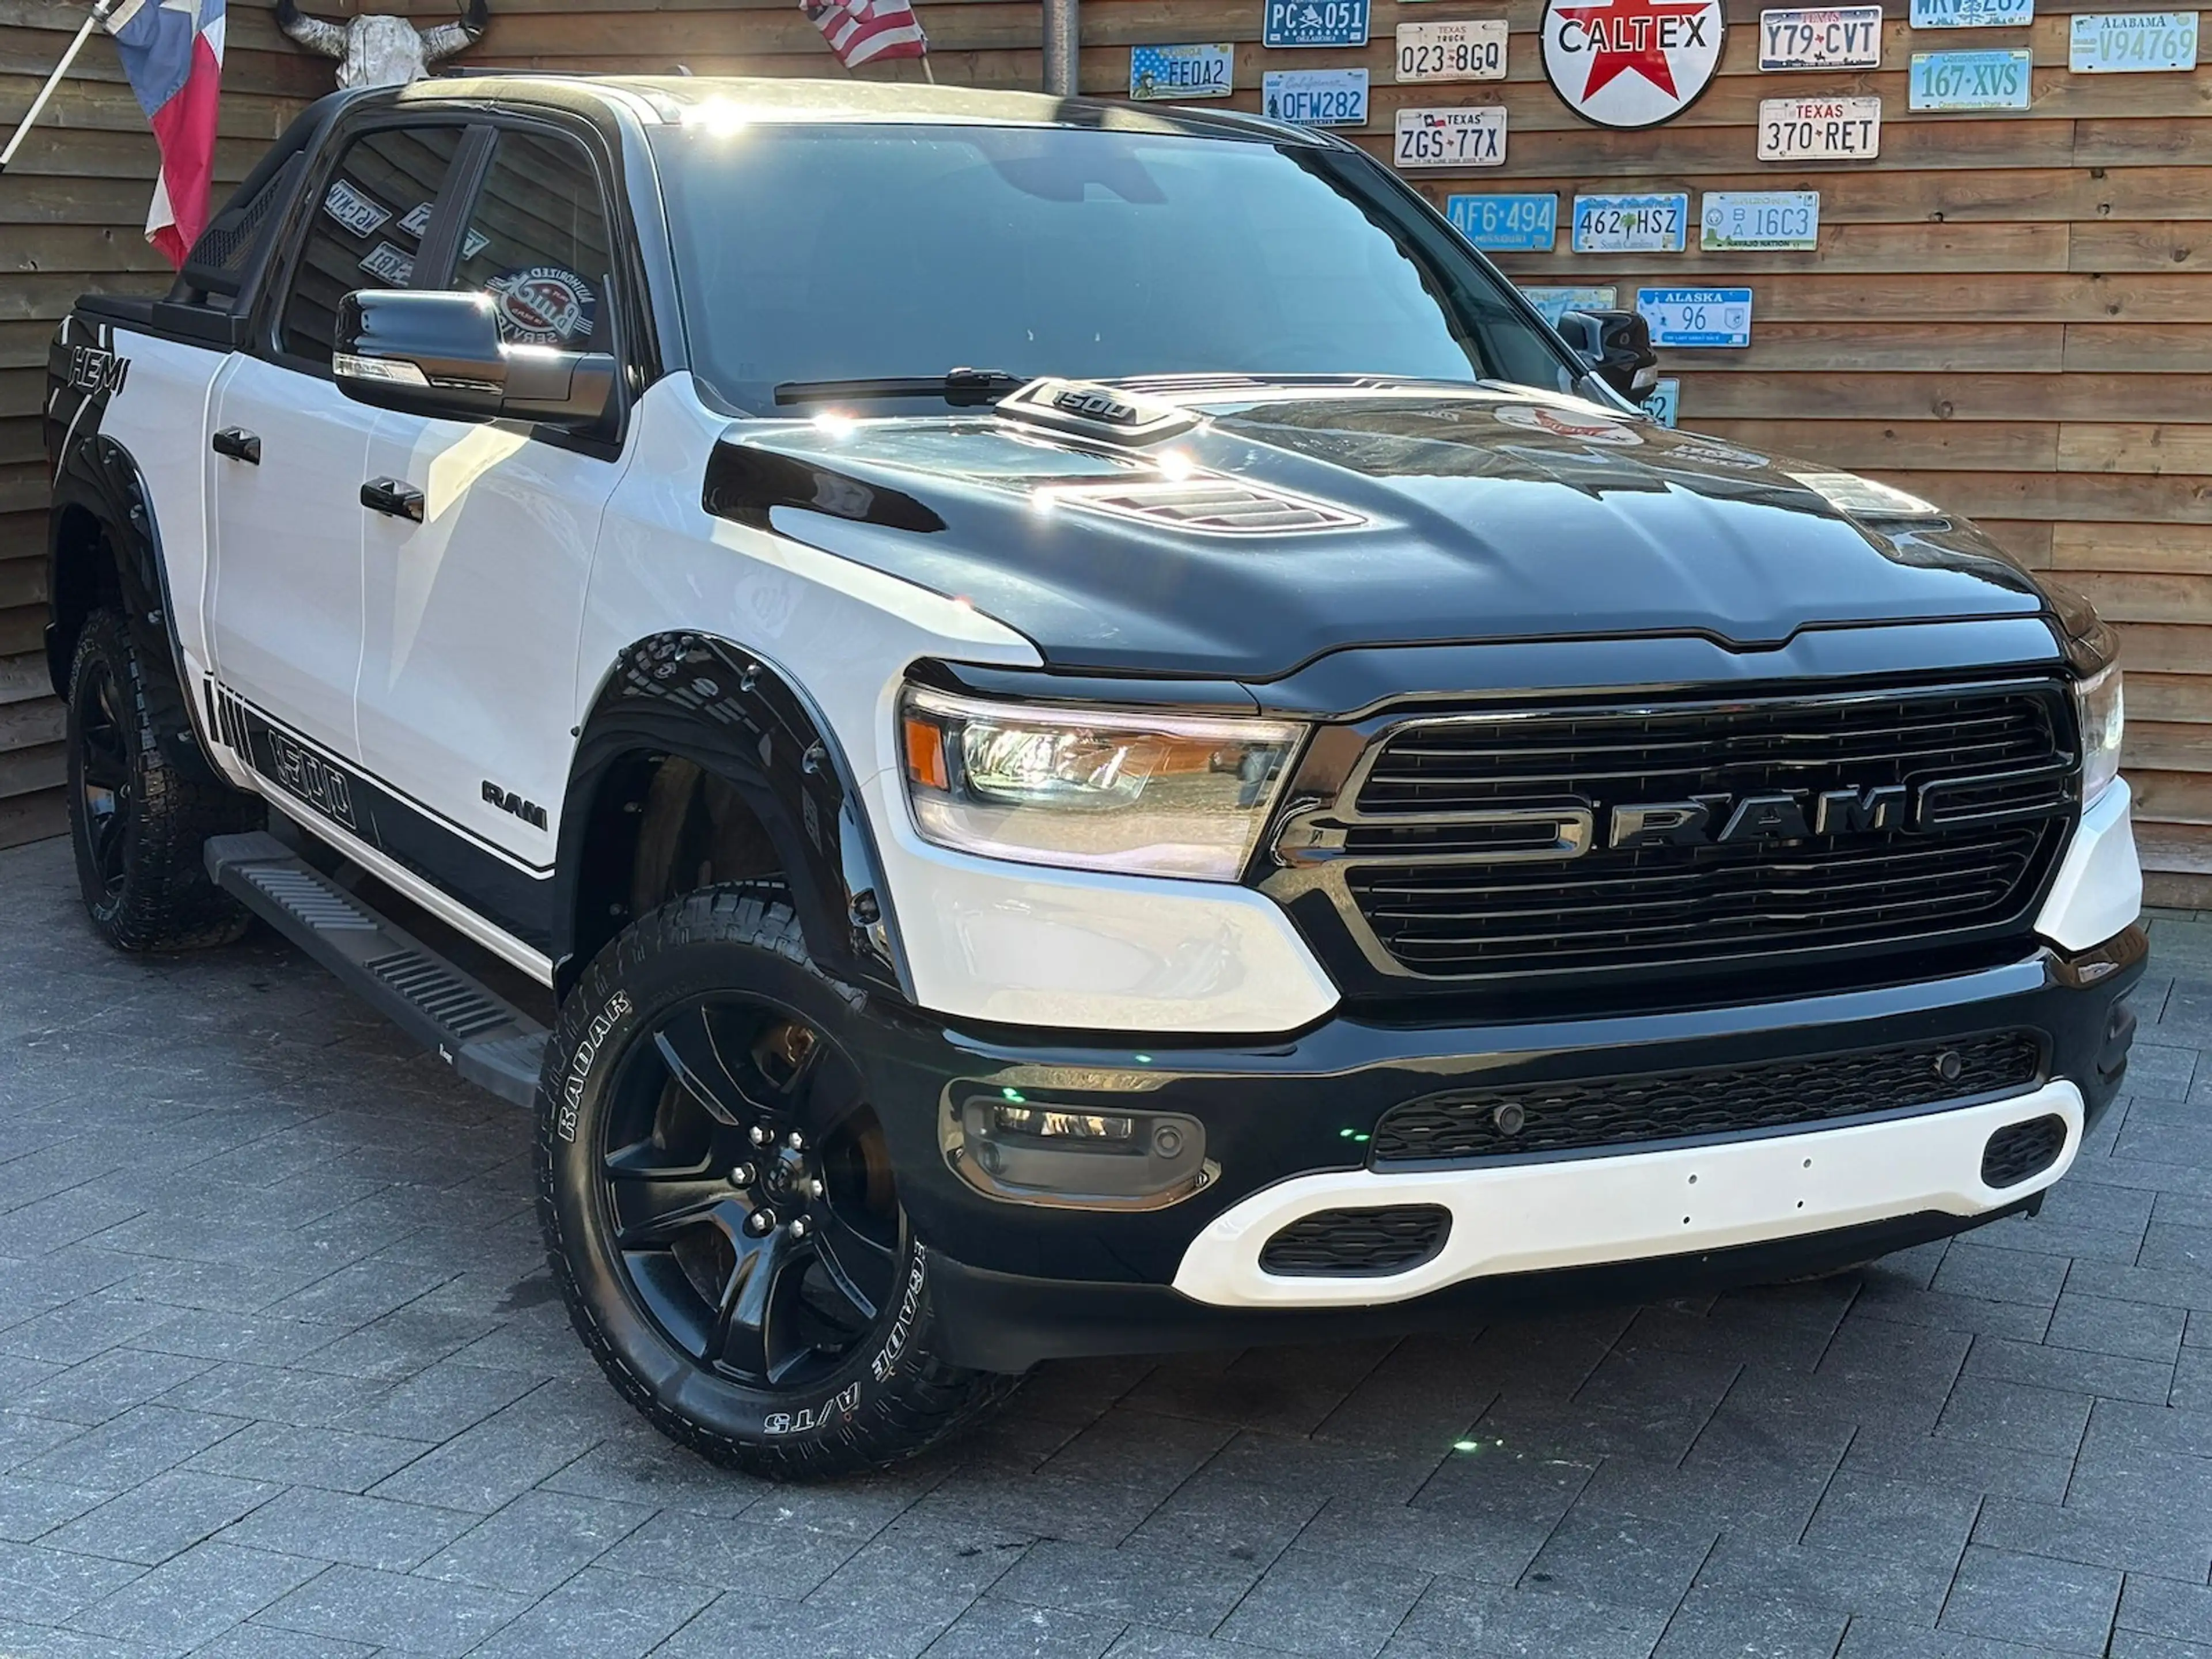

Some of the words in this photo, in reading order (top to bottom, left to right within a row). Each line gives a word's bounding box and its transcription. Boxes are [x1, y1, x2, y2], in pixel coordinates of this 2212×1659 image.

[1272, 3, 1297, 29] PC
[1325, 2, 1362, 28] 051
[1802, 12, 1841, 23] TEXAS
[2101, 15, 2166, 28] ALABAMA
[1558, 16, 1707, 53] CALTEX
[1826, 22, 1874, 54] CVT
[2099, 30, 2195, 61] V94769
[1402, 46, 1444, 73] 023
[1456, 43, 1498, 71] 8GQ
[1446, 114, 1482, 125] TEXAS
[1796, 104, 1844, 119] TEXAS
[1400, 130, 1443, 158] ZGS
[1456, 128, 1498, 157] 77X
[1766, 122, 1813, 151] 370
[1825, 120, 1873, 150] RET
[1580, 210, 1621, 234] 462
[1636, 209, 1677, 233] HSZ
[1665, 293, 1724, 302] ALASKA
[1682, 306, 1706, 331] 96
[67, 346, 132, 398] HEMI
[1052, 389, 1138, 425] 1500
[268, 728, 357, 830] 1500
[482, 779, 548, 832] RAM
[1609, 782, 1907, 849] RAM
[558, 988, 633, 1143] RADAR
